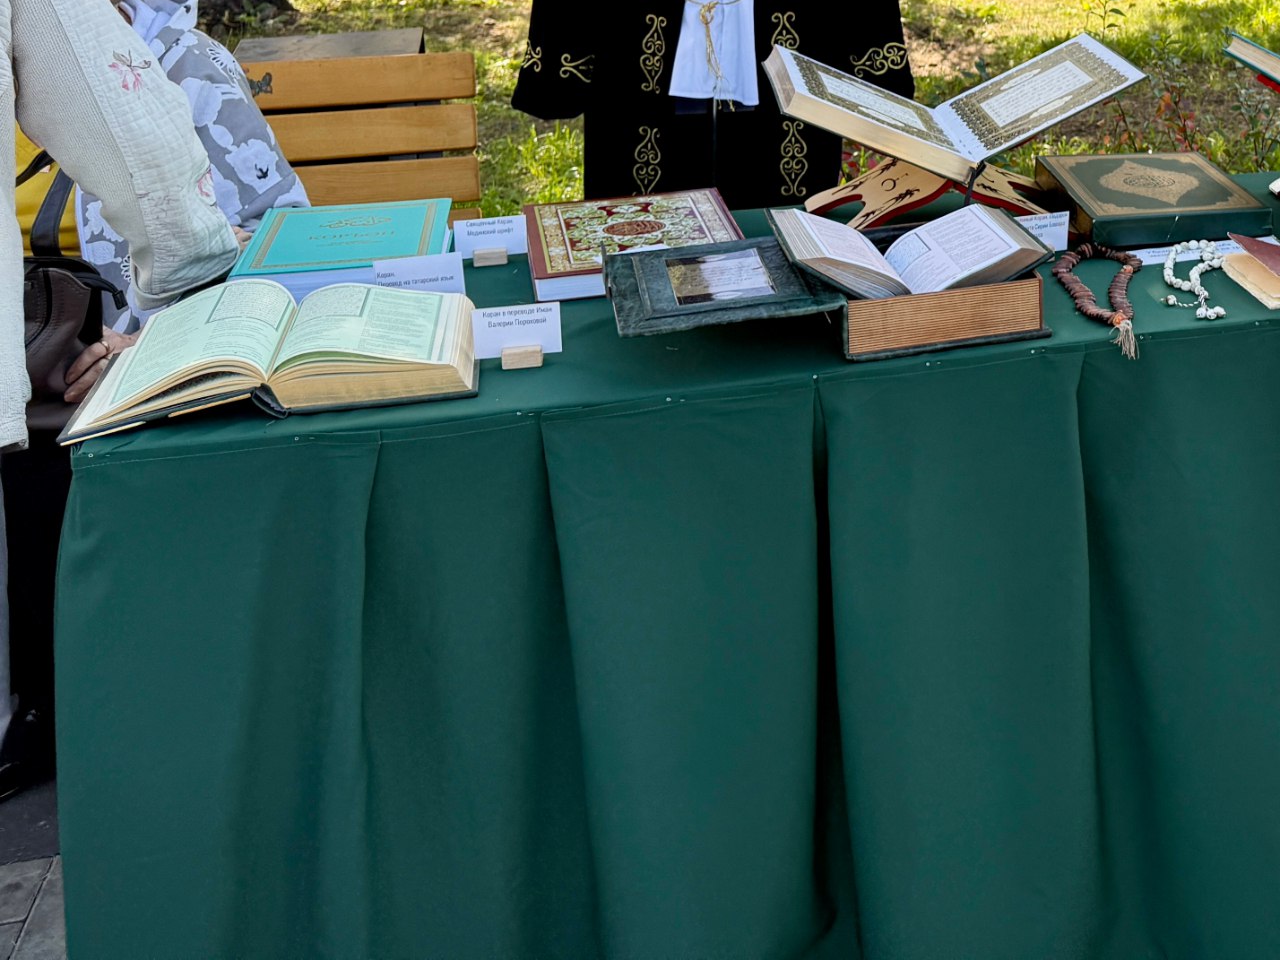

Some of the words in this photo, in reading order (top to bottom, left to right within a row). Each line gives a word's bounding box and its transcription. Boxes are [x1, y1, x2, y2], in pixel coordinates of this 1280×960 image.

[465, 219, 496, 228] Священный
[466, 228, 496, 236] Мединский
[496, 227, 514, 235] шрифт
[411, 276, 439, 285] татарский
[482, 310, 501, 319] Коран
[506, 308, 535, 317] переводе
[487, 320, 514, 329] Валерии
[514, 317, 547, 327] Пороховой
